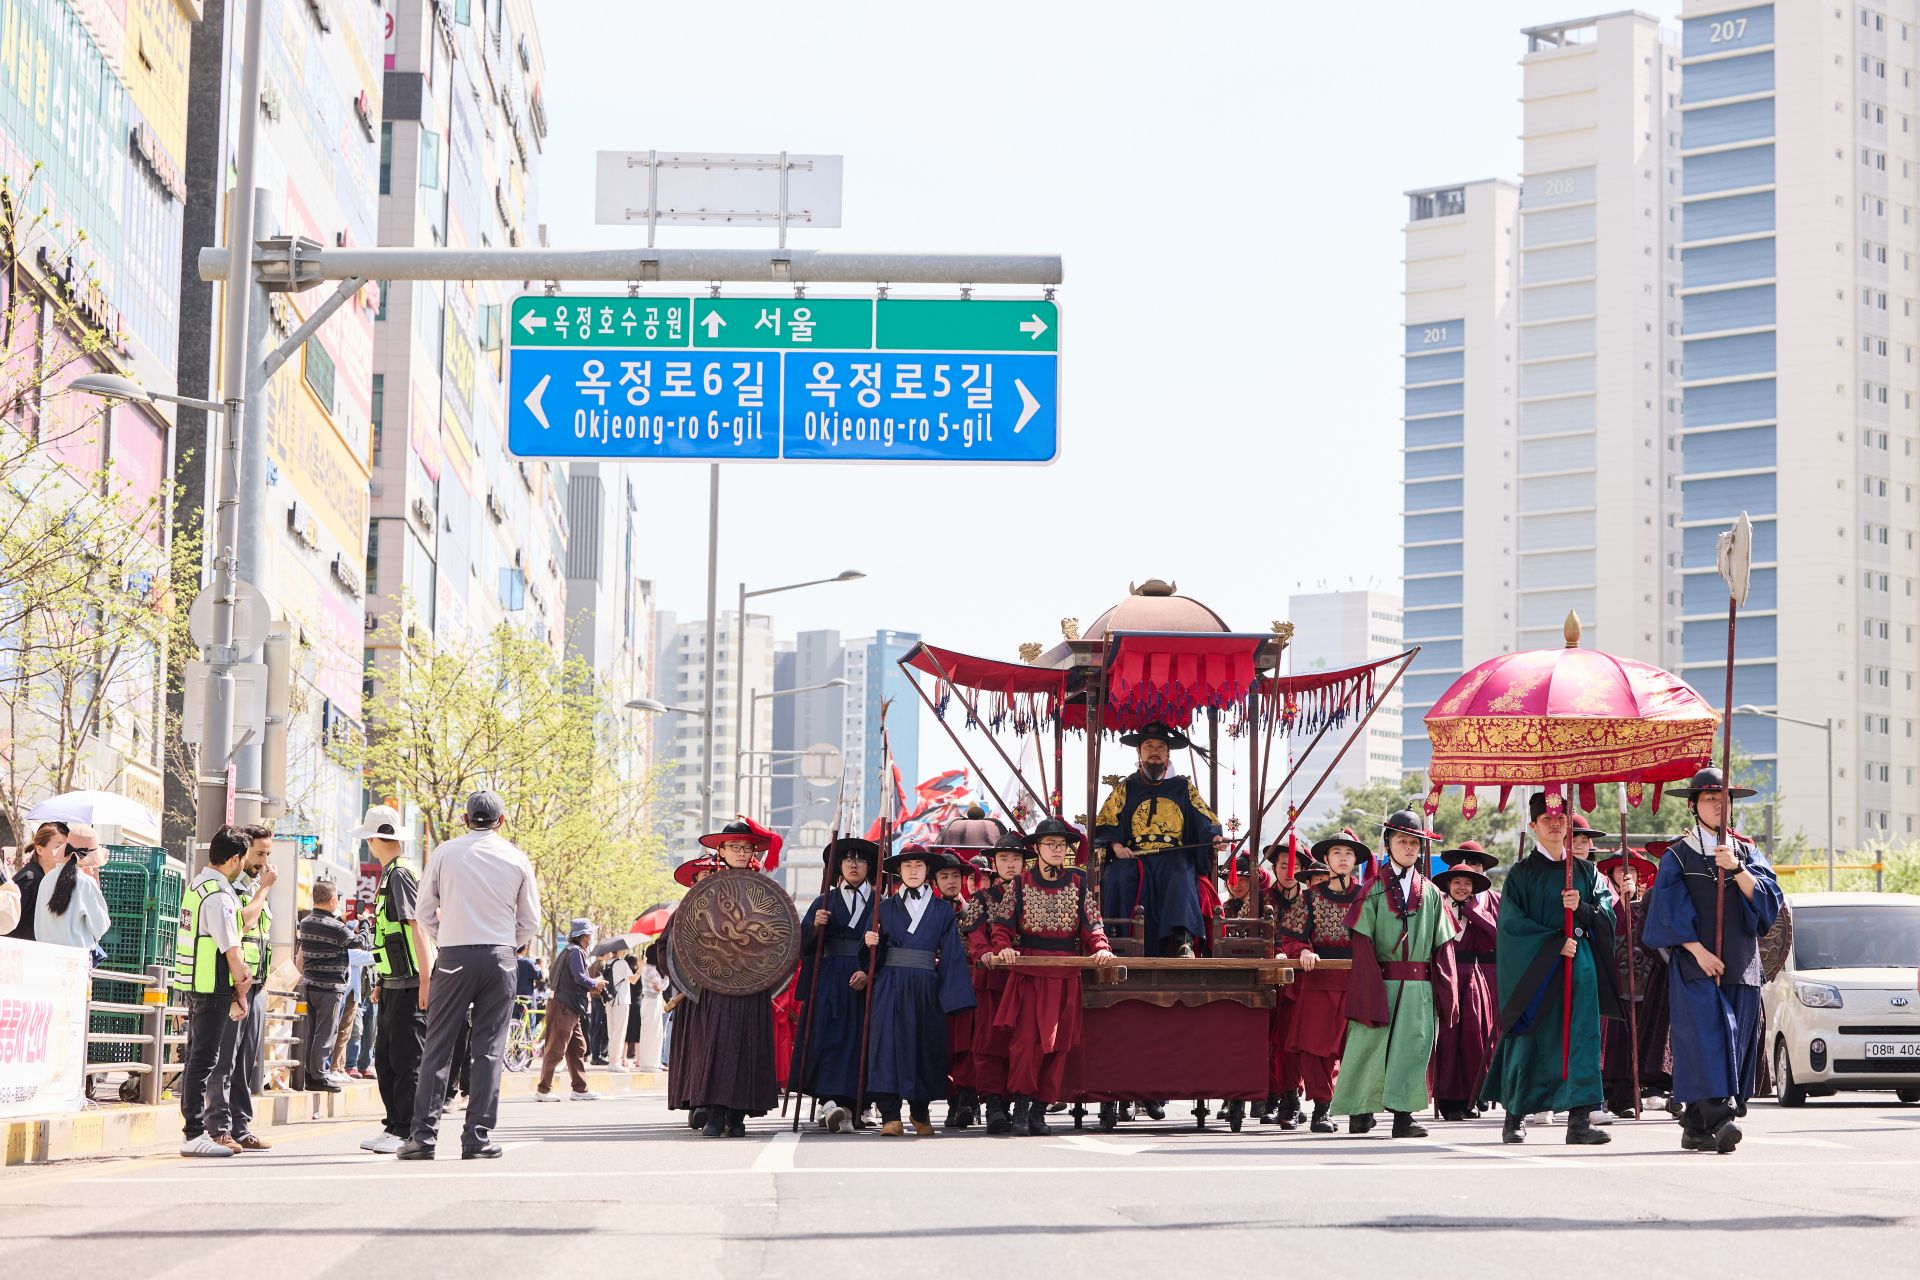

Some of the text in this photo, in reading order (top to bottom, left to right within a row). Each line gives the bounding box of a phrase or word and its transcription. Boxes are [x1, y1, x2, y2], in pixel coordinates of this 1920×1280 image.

[1710, 18, 1747, 43] 207
[1545, 177, 1575, 196] 208
[553, 305, 682, 340] 옥정호수공원
[754, 307, 817, 342] 서울
[1423, 328, 1447, 343] 201
[575, 359, 764, 407] 옥정로6길
[805, 361, 993, 409] 옥정로5길
[574, 408, 763, 446] Okjeong-ro 6-gil
[804, 411, 993, 448] Okjeong-ro 5-gil
[26, 1000, 53, 1063] 안내
[1872, 1044, 1895, 1056] 08머
